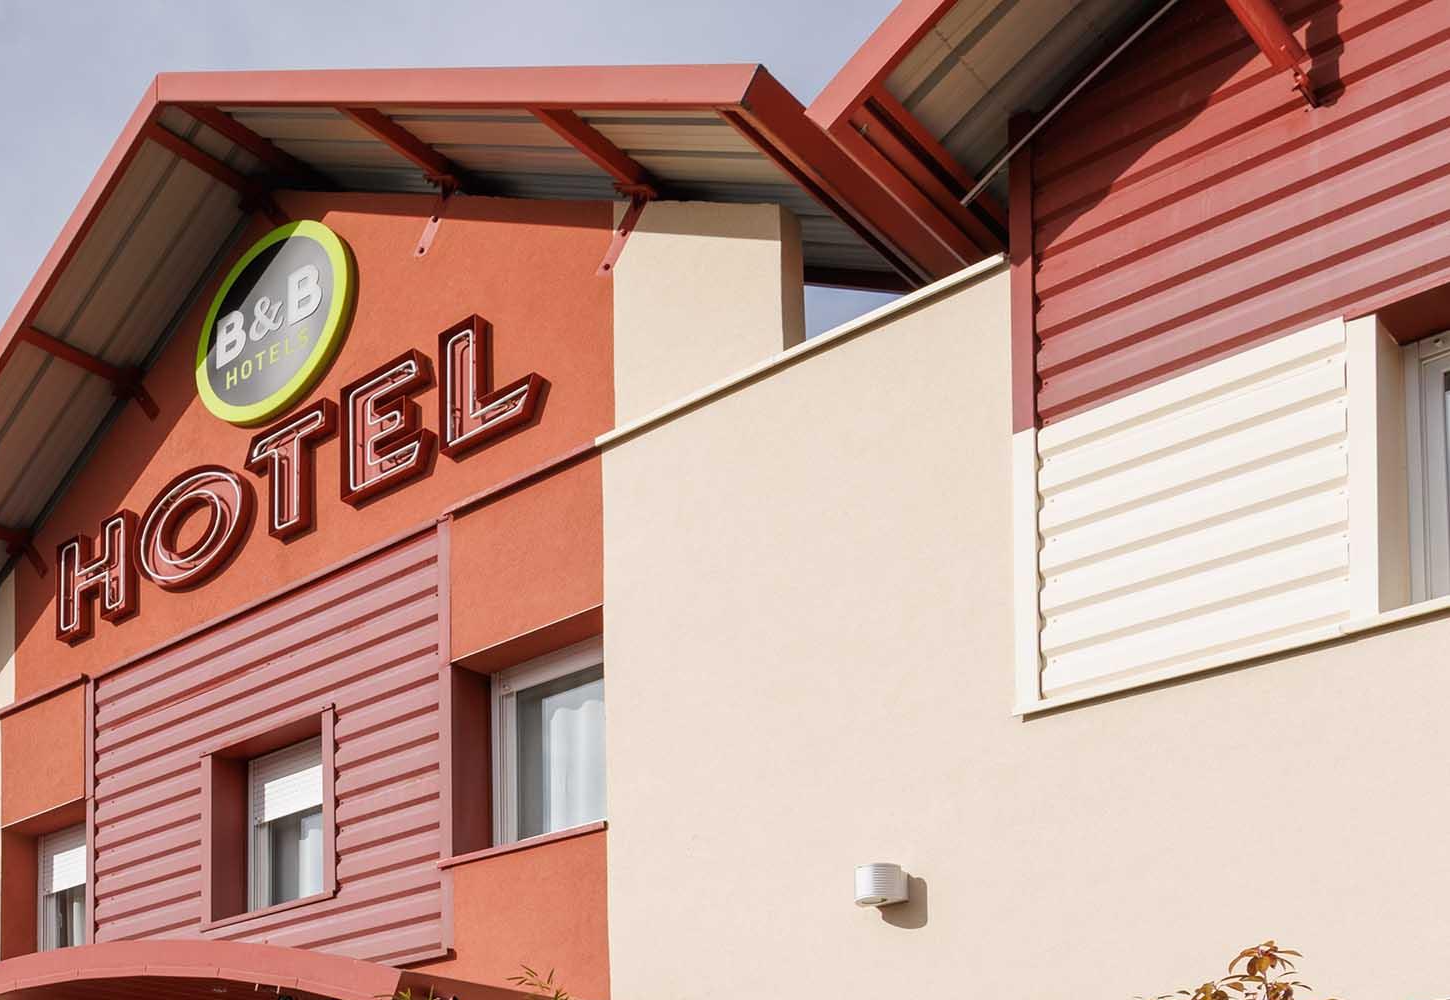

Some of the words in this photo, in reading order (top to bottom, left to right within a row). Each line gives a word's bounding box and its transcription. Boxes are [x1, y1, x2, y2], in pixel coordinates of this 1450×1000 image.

[217, 264, 323, 369] B&B
[225, 328, 310, 390] HOTELS
[56, 313, 551, 645] HOTEL
